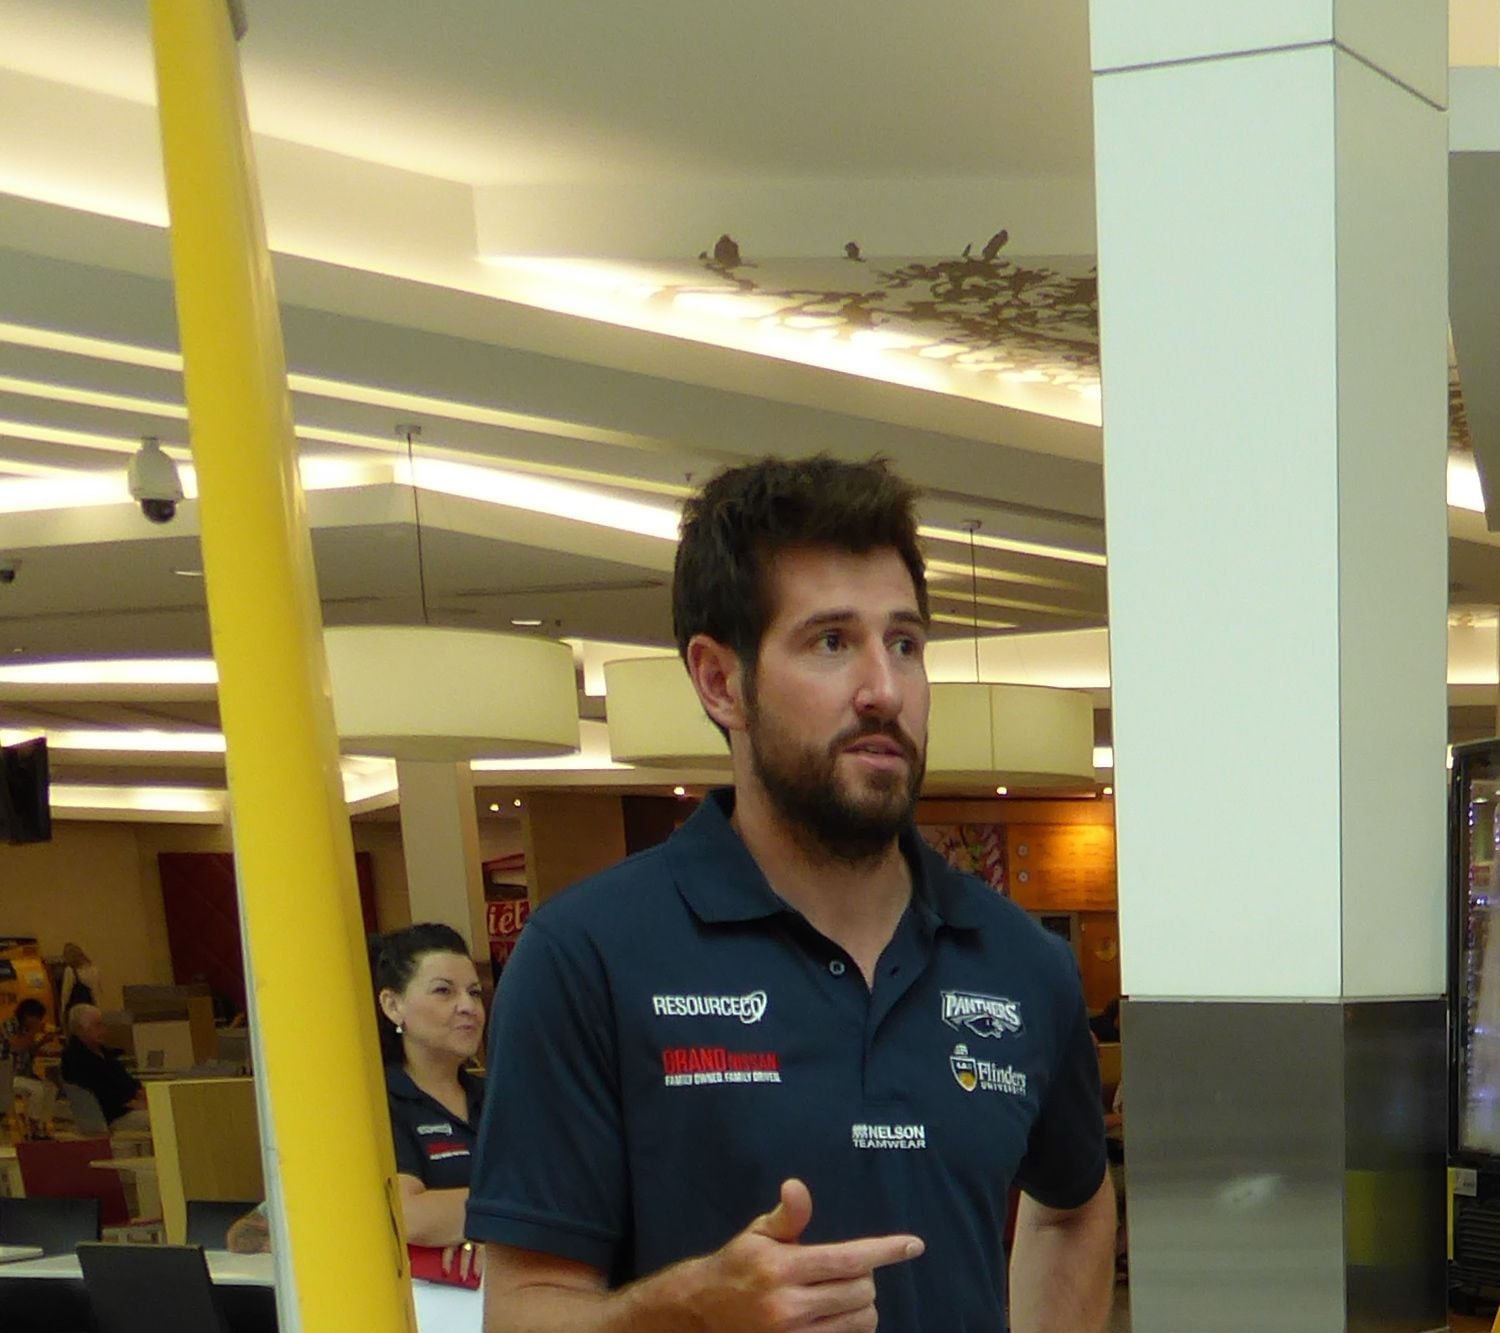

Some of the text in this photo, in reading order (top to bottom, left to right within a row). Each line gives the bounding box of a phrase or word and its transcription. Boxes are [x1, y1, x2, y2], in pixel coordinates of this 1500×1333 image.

[945, 994, 1021, 1026] PANTHERS
[977, 1061, 1026, 1088] Flinders
[868, 1124, 925, 1139] NELSON
[852, 1139, 926, 1149] TEAMWEAR
